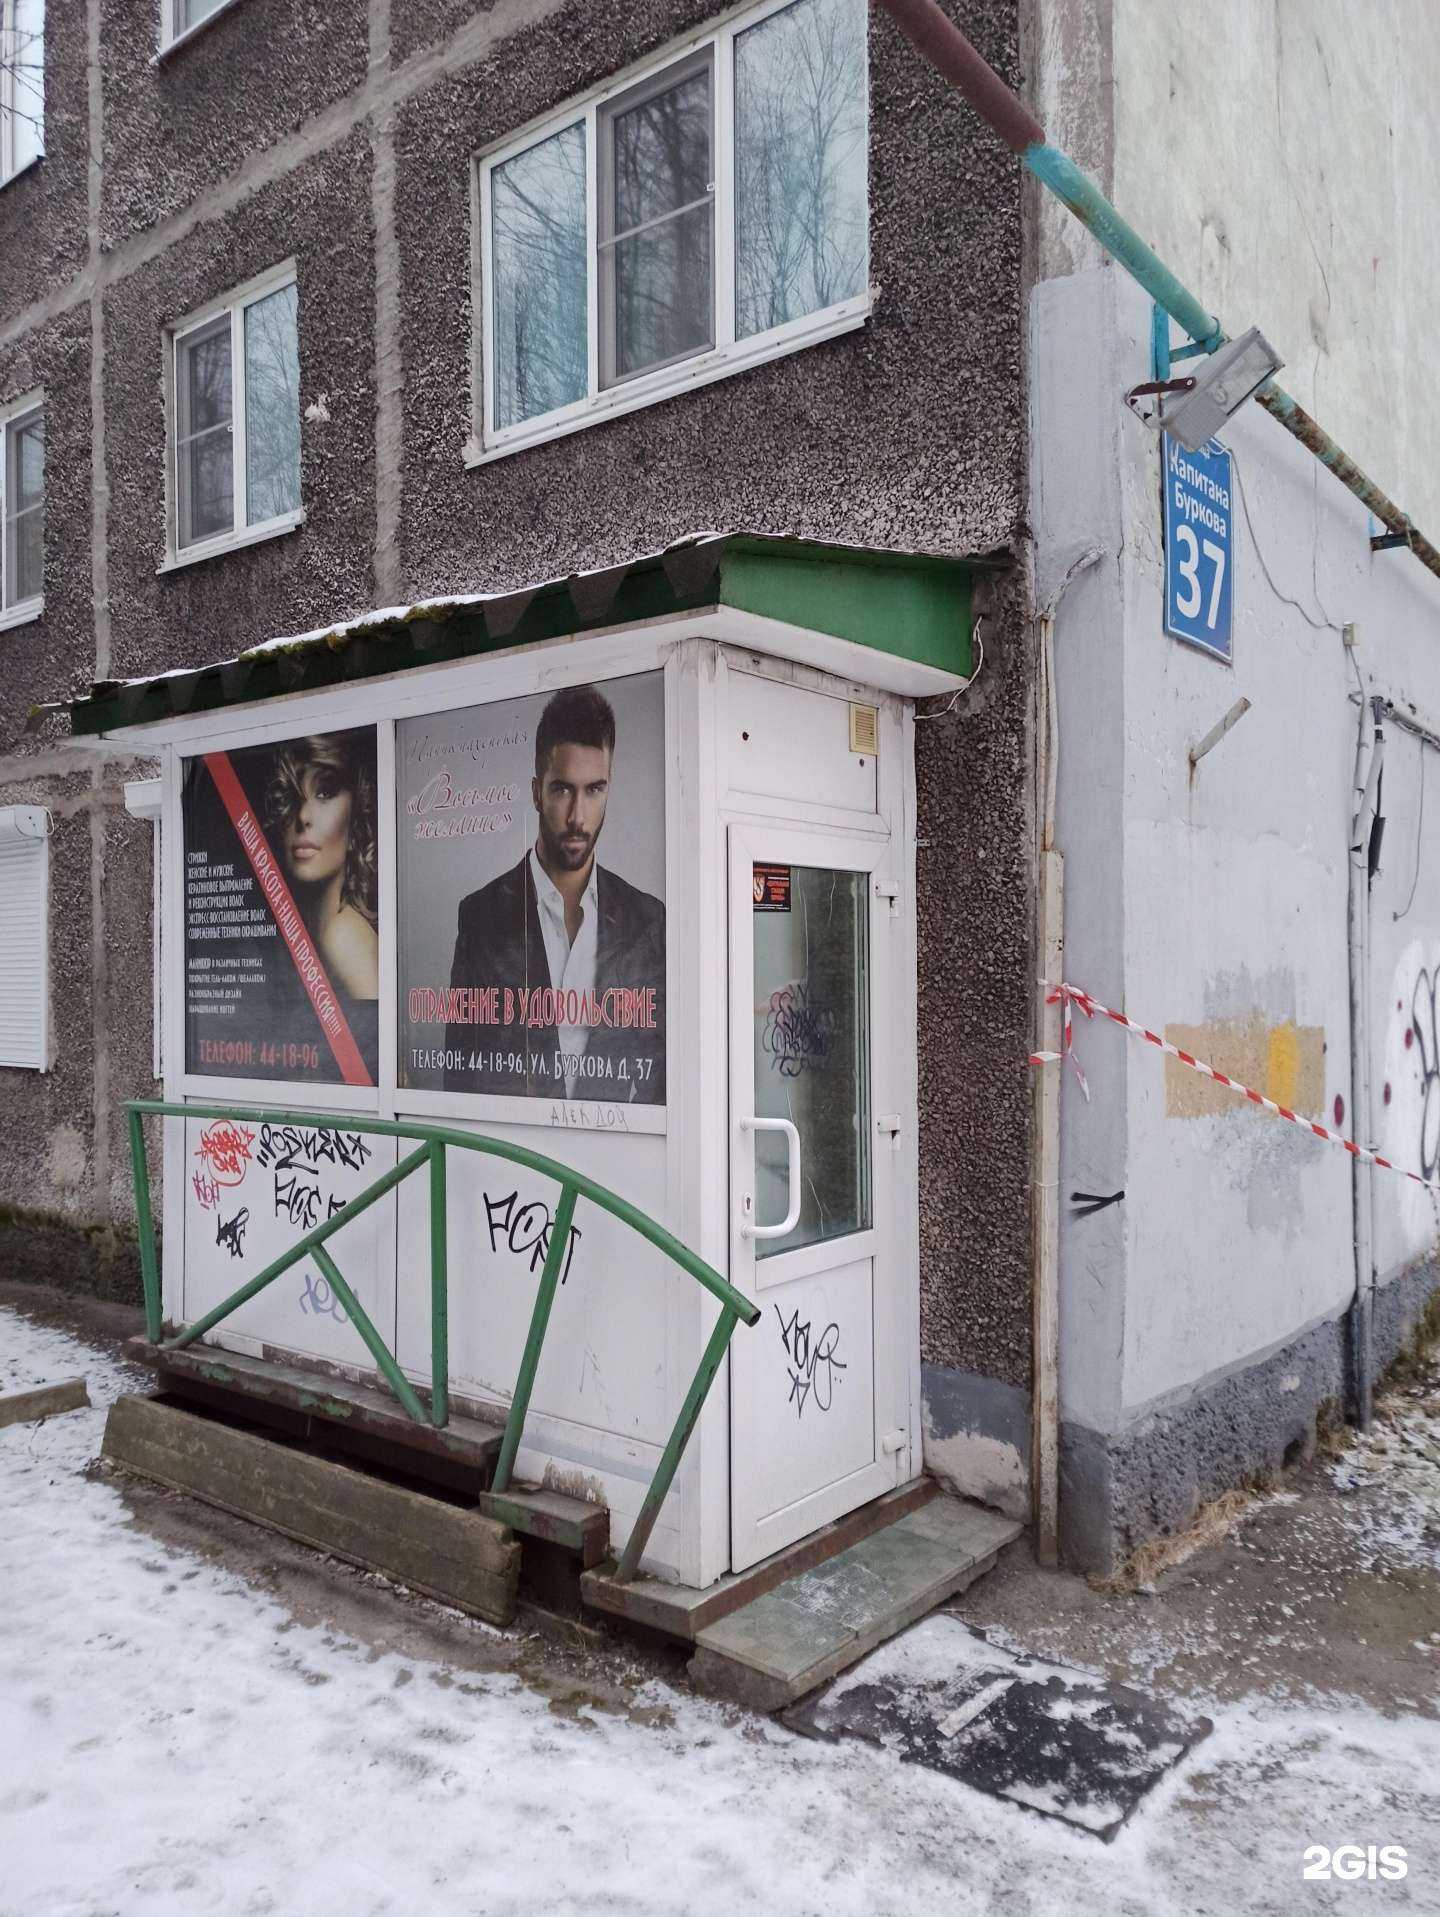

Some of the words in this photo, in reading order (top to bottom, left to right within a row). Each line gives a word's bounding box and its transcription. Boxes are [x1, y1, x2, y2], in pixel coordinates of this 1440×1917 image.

[1170, 453, 1229, 511] Капитана
[1175, 481, 1226, 538] Буркова
[1176, 524, 1225, 630] 37
[237, 811, 256, 852] ВАША
[408, 985, 500, 1025] ОТРАЖЕНИЕ
[502, 987, 516, 1026] В
[517, 985, 657, 1029] УДОВОЛЬСТВИЕ
[199, 1039, 256, 1065] ТЕЛЕФОН:
[260, 1041, 319, 1069] 44-18-96
[411, 1049, 465, 1071] ТЕЛЕФОН:
[468, 1051, 528, 1076] 44-18-96,
[530, 1054, 550, 1075] УЛ.
[617, 1056, 631, 1081] Д.
[635, 1057, 654, 1081] 37
